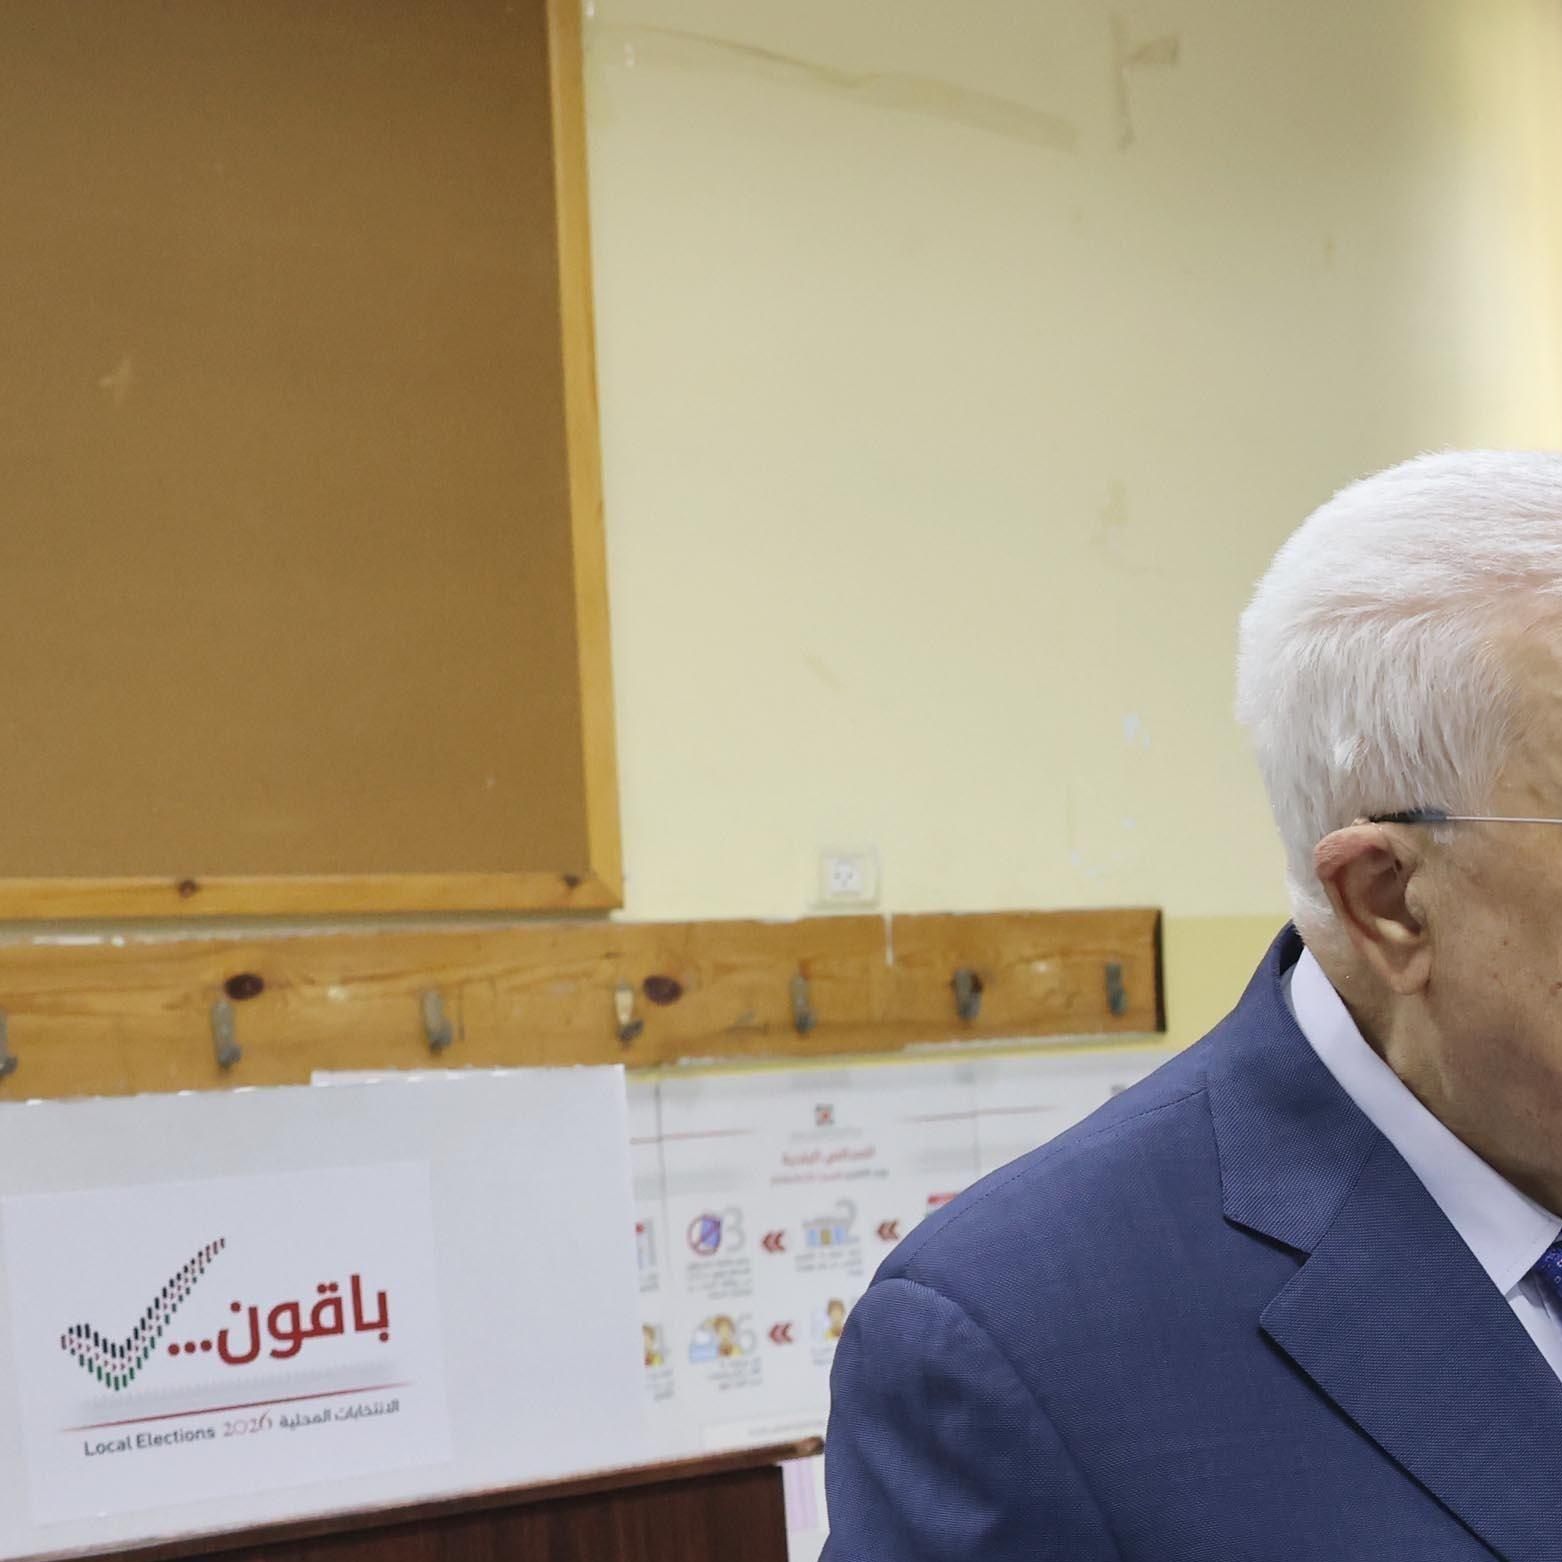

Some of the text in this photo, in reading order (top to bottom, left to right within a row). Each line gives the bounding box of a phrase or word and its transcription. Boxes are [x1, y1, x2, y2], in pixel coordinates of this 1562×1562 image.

[724, 1205, 746, 1252] 3
[167, 1273, 389, 1366] باقون...
[84, 1400, 400, 1457] Local Elections 2026 الانتخابات المحلية
